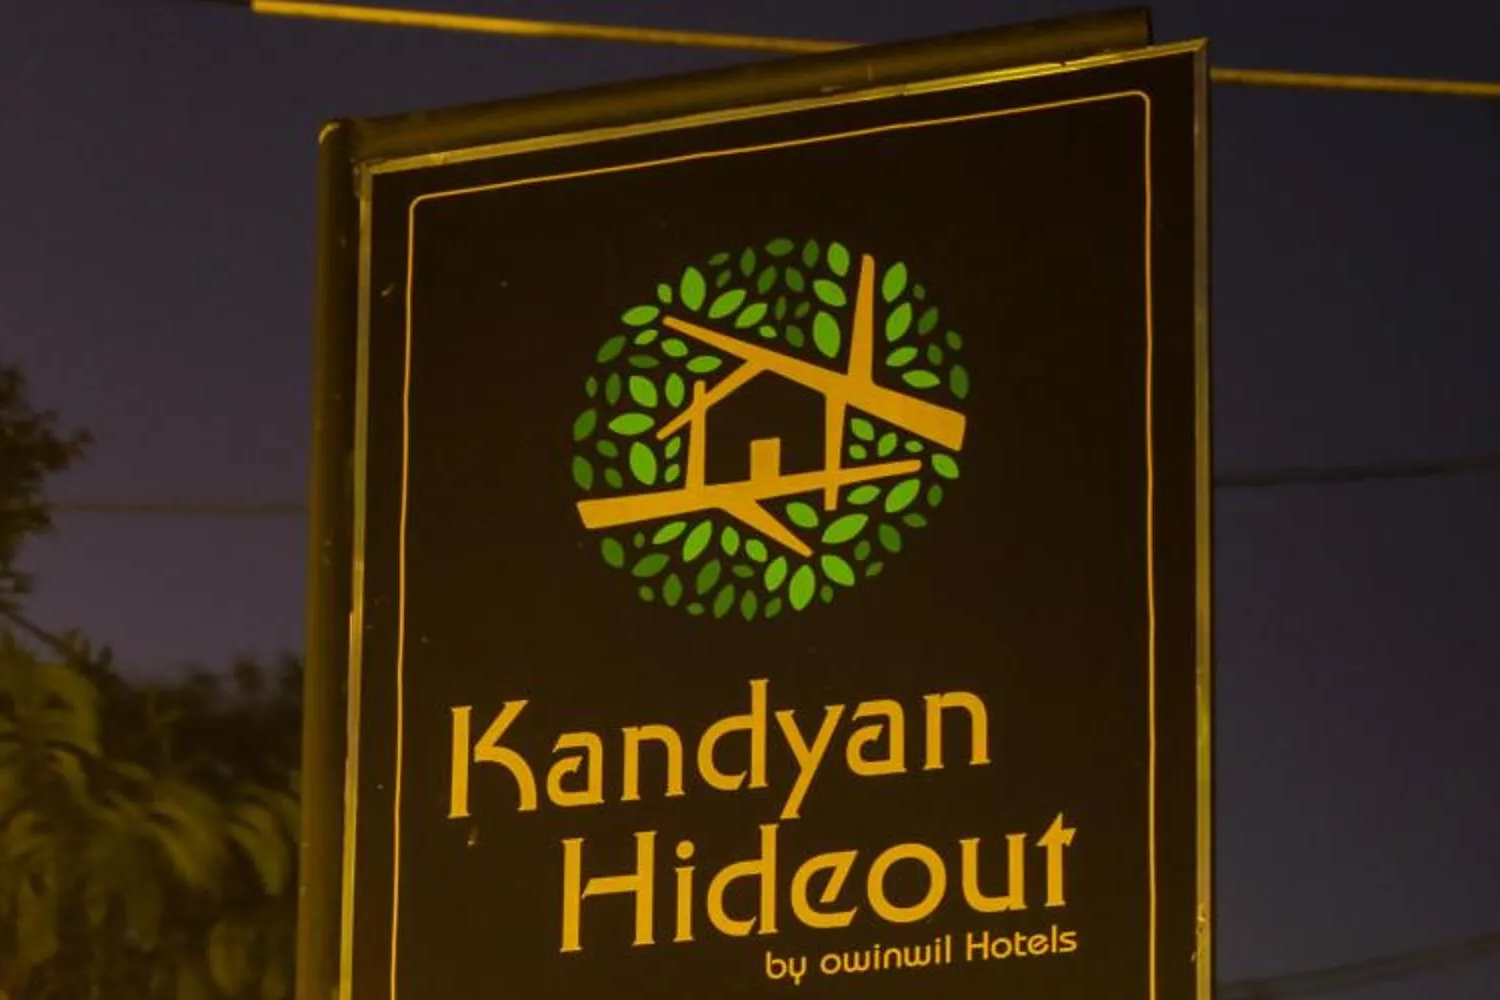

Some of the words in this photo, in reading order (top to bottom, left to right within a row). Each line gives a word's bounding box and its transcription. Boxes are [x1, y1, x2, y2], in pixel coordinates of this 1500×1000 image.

[448, 678, 990, 820] Kandyan
[559, 812, 1077, 953] Hideout
[765, 951, 807, 985] by
[966, 924, 1077, 961] Hotels
